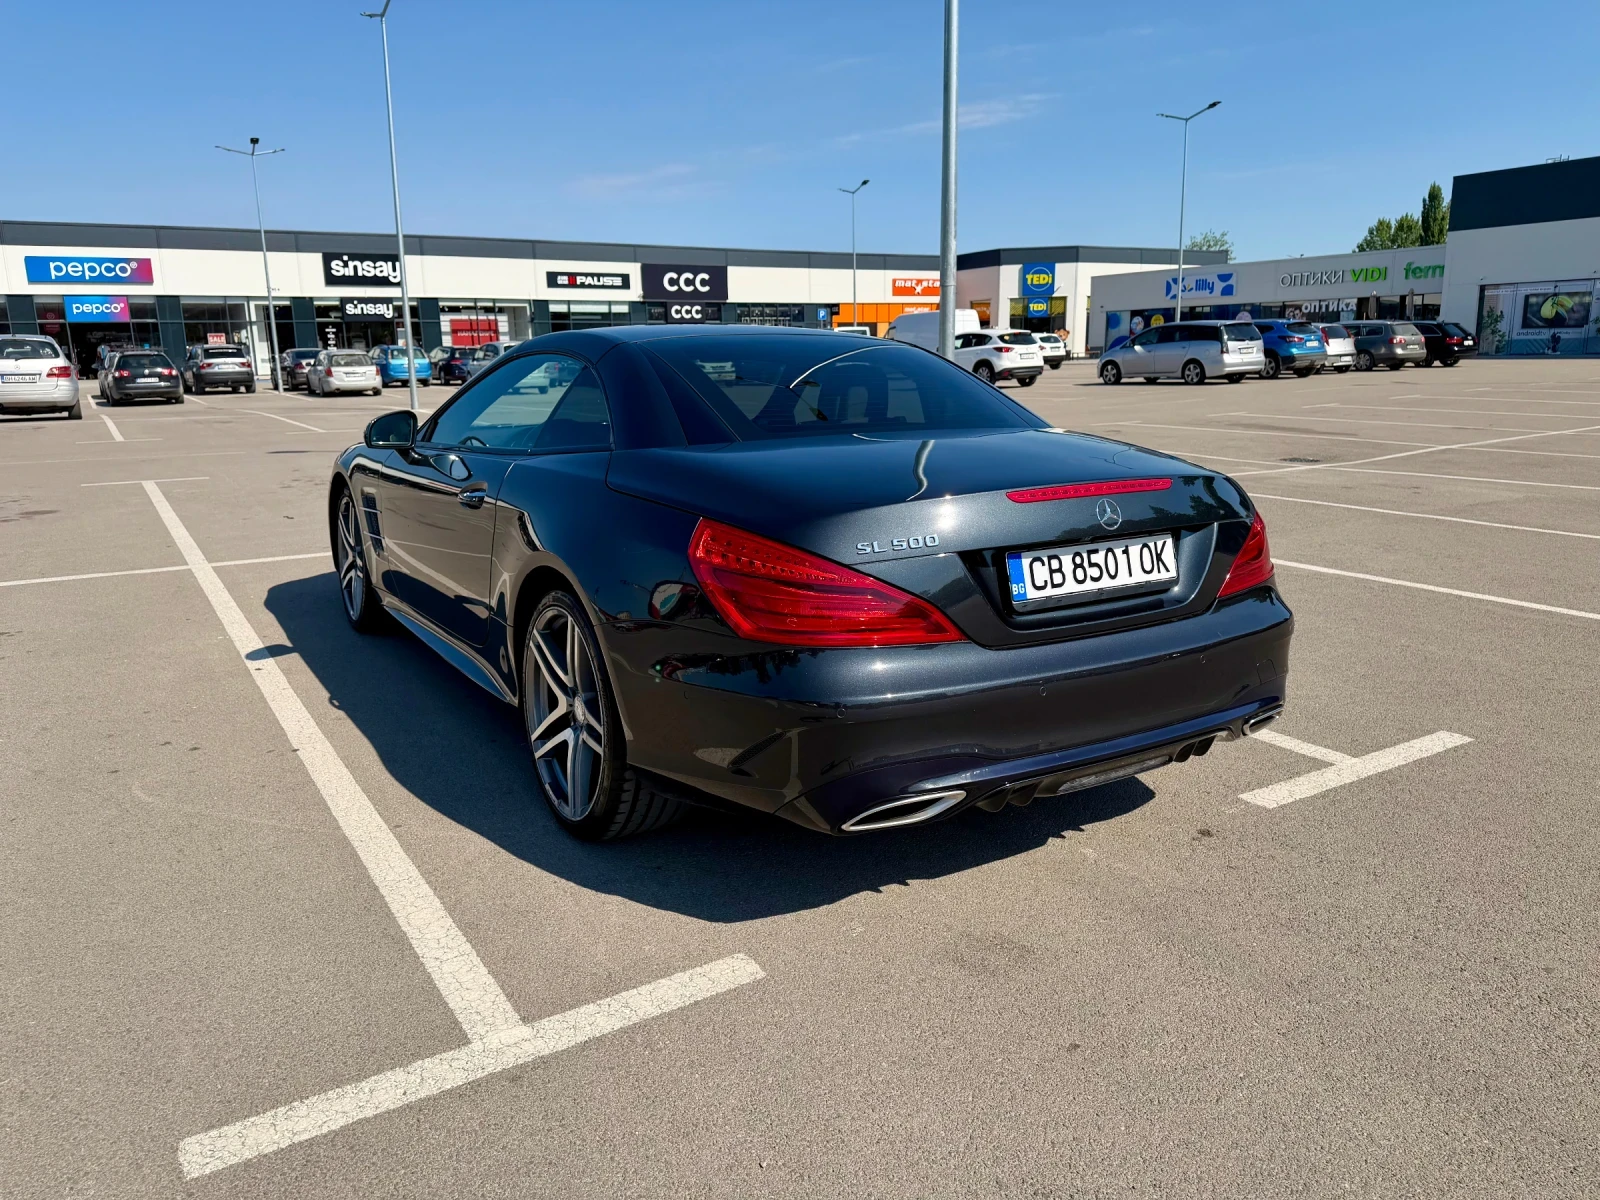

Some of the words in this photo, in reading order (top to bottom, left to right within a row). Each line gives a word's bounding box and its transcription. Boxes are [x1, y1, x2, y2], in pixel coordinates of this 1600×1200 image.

[49, 261, 131, 279] pepco
[330, 255, 401, 283] sinsay
[1279, 270, 1344, 288] ОПТИКИ
[1350, 266, 1387, 282] VIDI
[576, 275, 622, 286] PAUSE
[663, 272, 710, 292] CCC
[921, 279, 940, 287] sta
[1195, 278, 1215, 295] lilly
[72, 303, 121, 314] pepco
[345, 300, 393, 319] sinsay
[670, 304, 703, 319] CCC
[1301, 300, 1357, 313] ОПТИКА
[856, 540, 888, 555] SL
[891, 533, 940, 551] 500
[1029, 553, 1067, 592] CB
[1071, 544, 1133, 585] 8501
[1139, 540, 1171, 575] OK
[1011, 582, 1025, 595] BG
